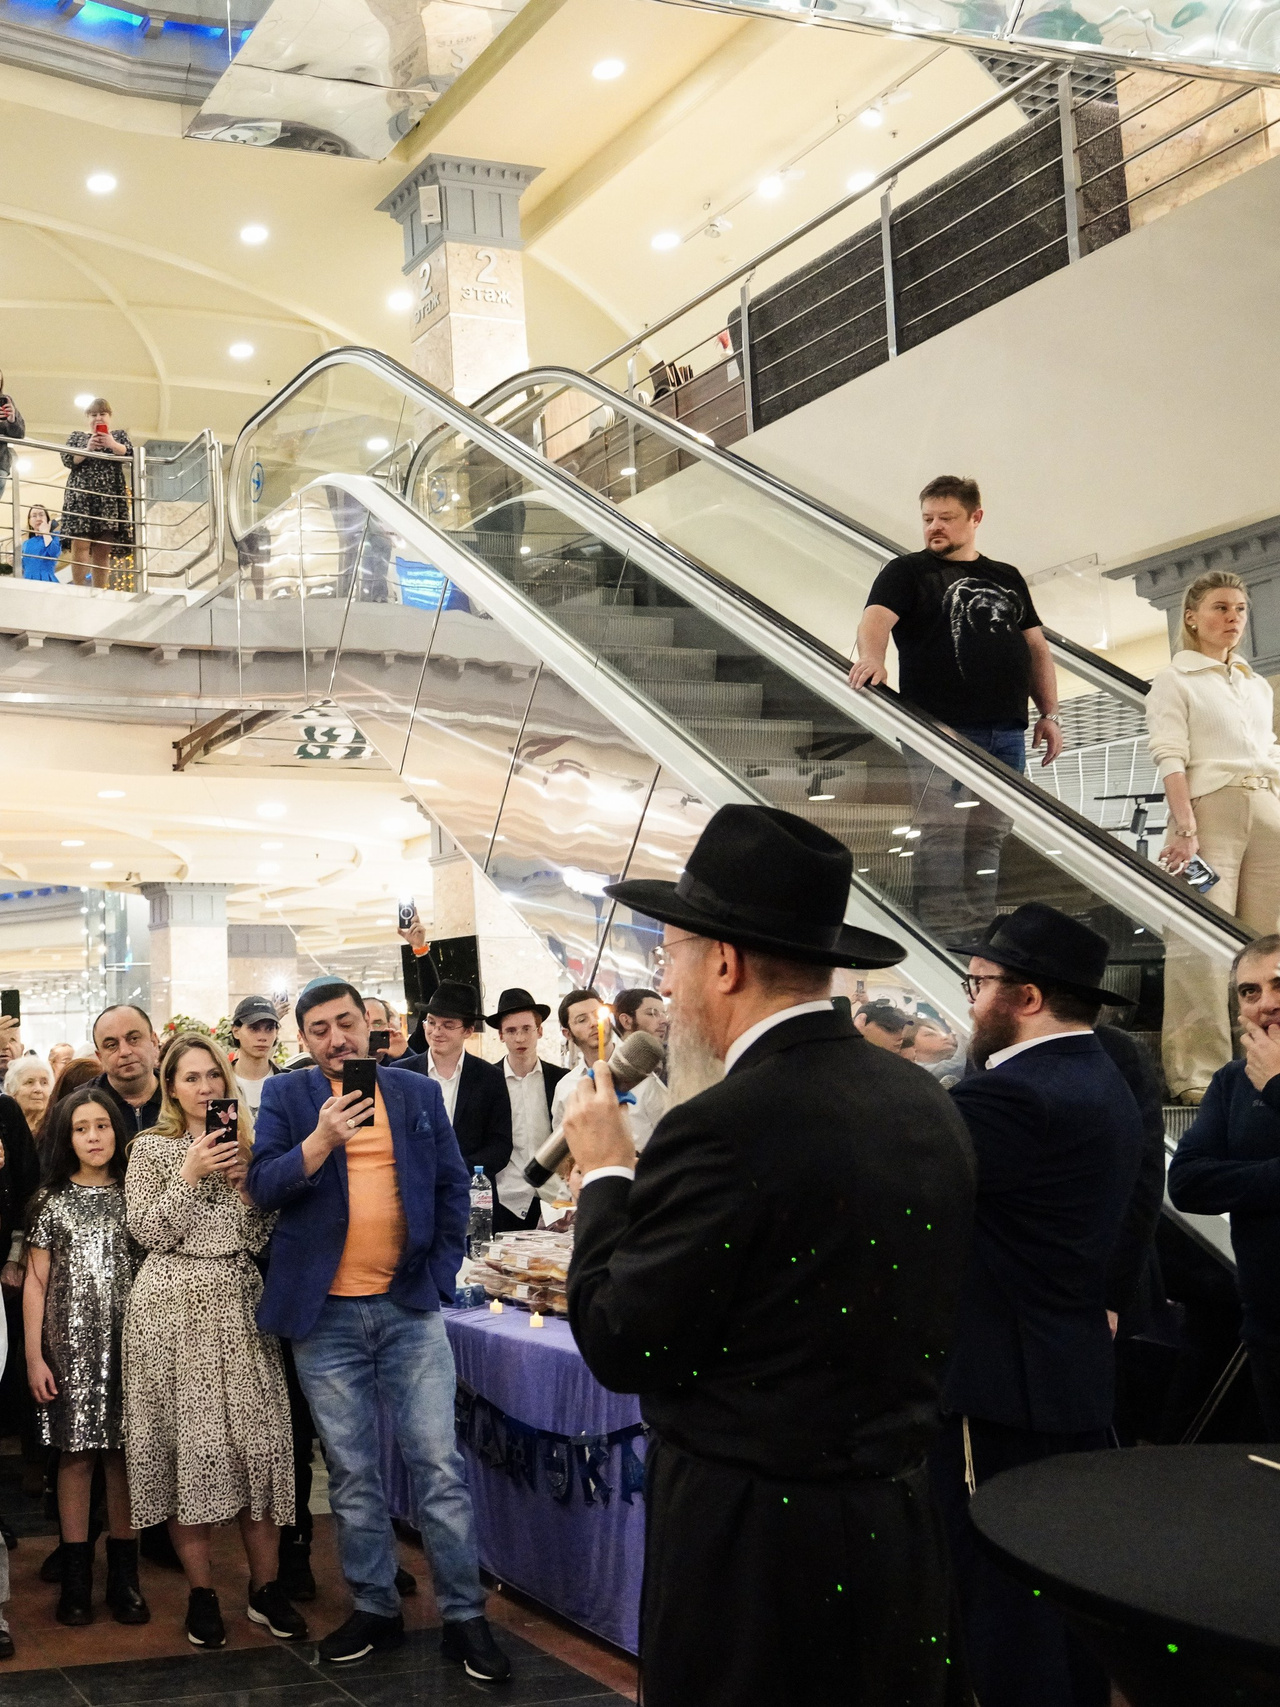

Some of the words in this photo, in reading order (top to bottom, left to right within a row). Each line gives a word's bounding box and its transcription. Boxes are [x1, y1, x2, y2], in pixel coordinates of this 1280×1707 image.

[420, 262, 433, 301] 2
[476, 250, 499, 285] 2
[414, 292, 440, 324] этаж
[461, 287, 512, 305] этаж
